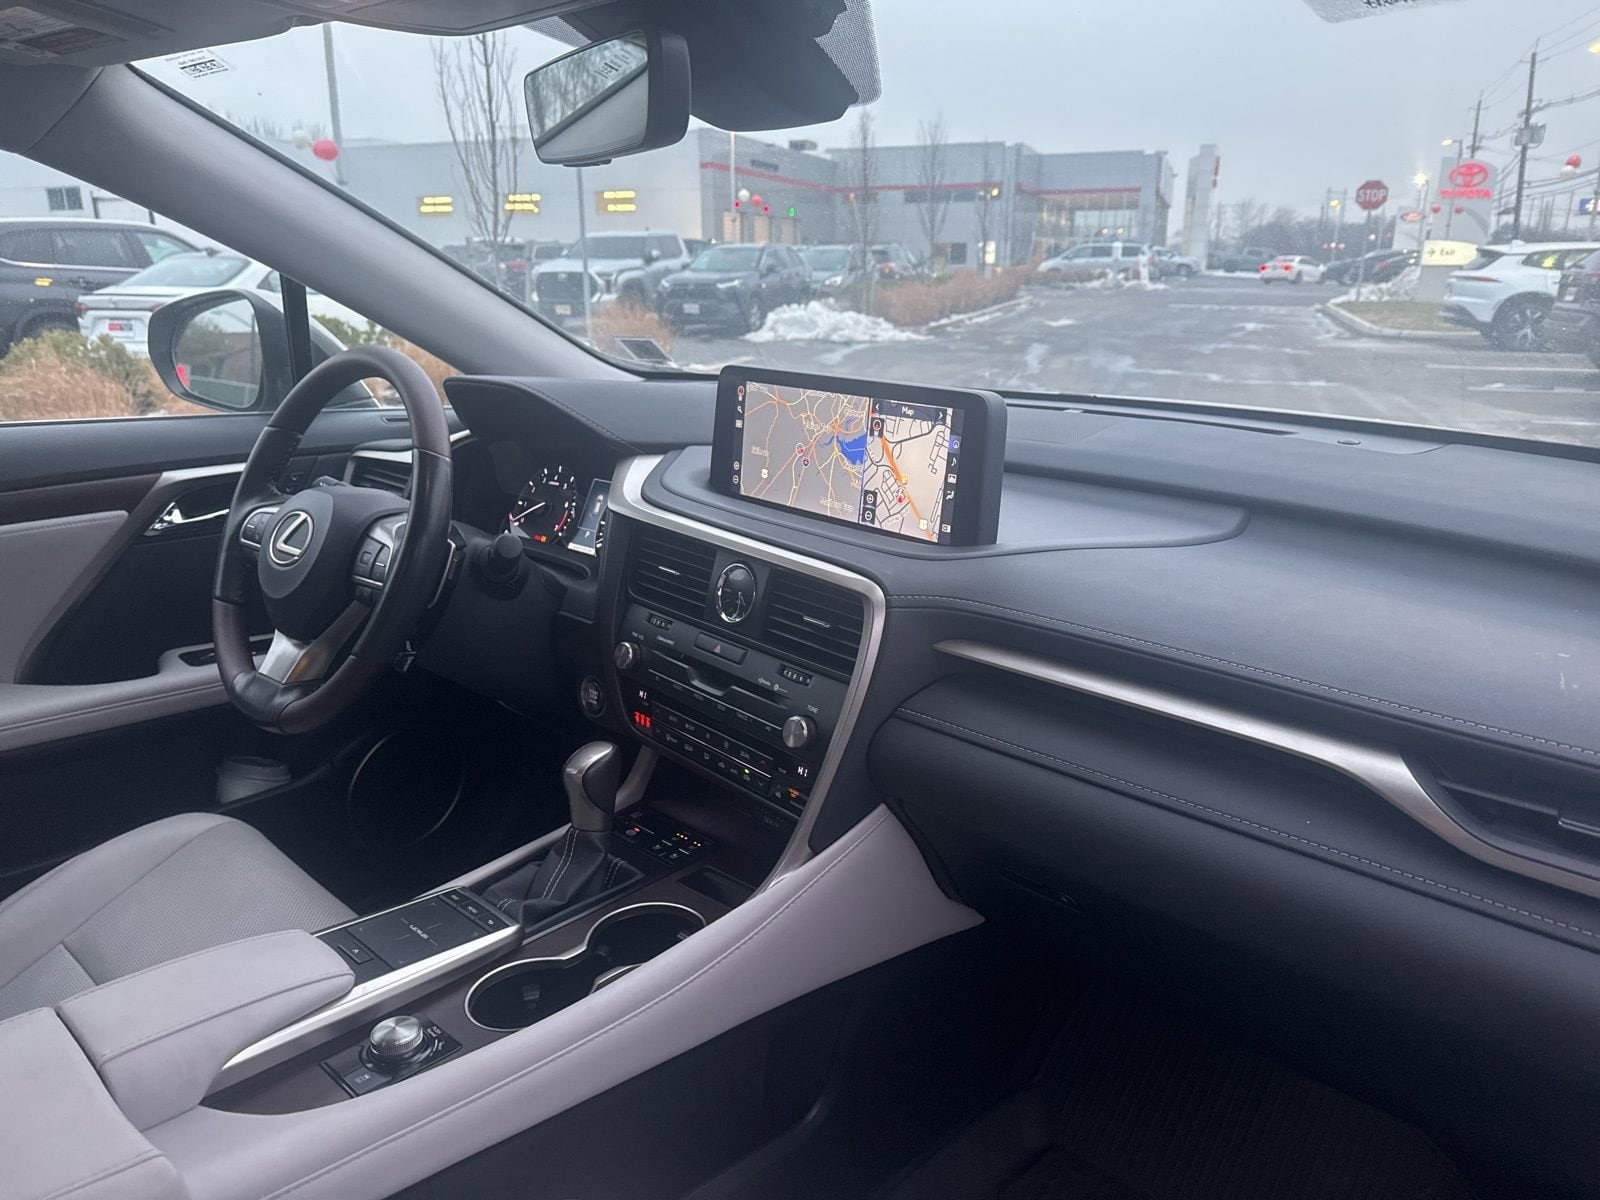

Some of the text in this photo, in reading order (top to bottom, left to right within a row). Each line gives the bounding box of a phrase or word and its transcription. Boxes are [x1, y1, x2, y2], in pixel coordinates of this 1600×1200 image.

[1358, 188, 1387, 202] STOP
[1441, 188, 1492, 200] TOYOTA
[901, 405, 915, 417] Map
[409, 924, 430, 940] LEXUS
